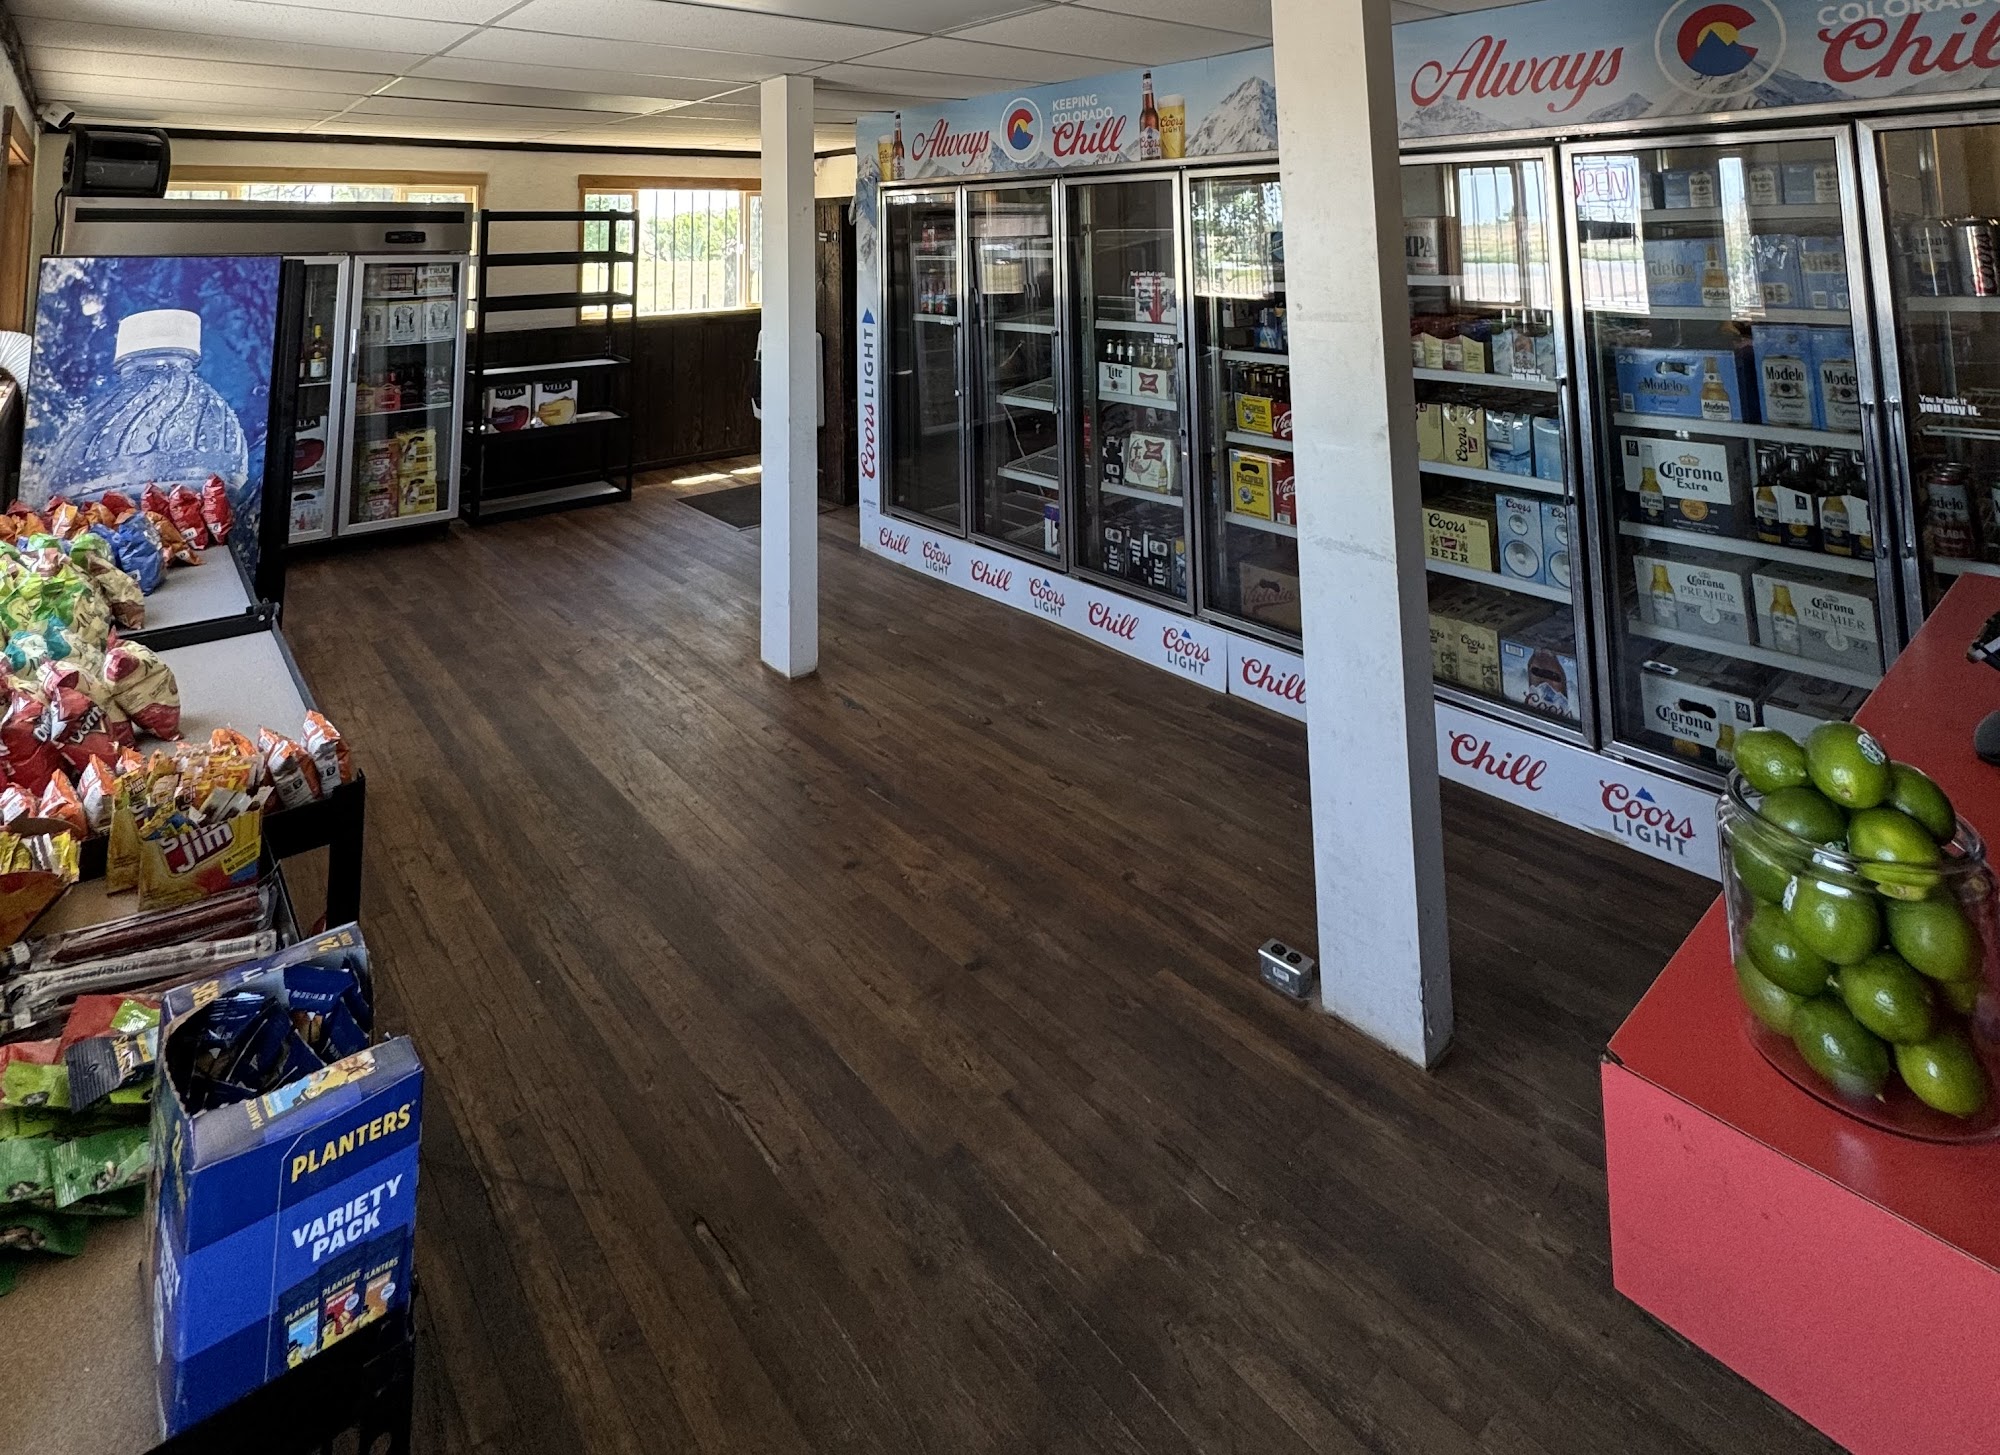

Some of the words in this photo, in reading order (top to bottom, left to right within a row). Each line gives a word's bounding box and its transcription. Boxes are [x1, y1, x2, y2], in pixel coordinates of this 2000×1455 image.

[1411, 34, 1624, 113] Always
[1052, 94, 1098, 111] KEEPING
[1052, 106, 1113, 126] COLORADO
[911, 118, 990, 168] Always
[1052, 115, 1127, 158] Chill
[863, 328, 874, 399] LIGHT
[1619, 355, 1634, 365] 24
[1643, 377, 1683, 392] Modelo
[1765, 366, 1804, 382] Modelo
[1824, 370, 1857, 386] Mode
[498, 388, 523, 397] VELLA
[544, 383, 570, 391] VELLA
[1919, 402, 1942, 413] you
[1943, 403, 1967, 416] buy
[860, 402, 876, 481] Coors
[1456, 427, 1468, 462] Coors
[1659, 461, 1724, 483] Corona
[1677, 478, 1708, 492] Extra
[1505, 498, 1532, 514] Coors
[1428, 512, 1467, 534] Coors
[879, 527, 911, 555] Chill
[922, 540, 952, 565] Coors
[1431, 547, 1469, 564] BEER
[925, 559, 949, 575] LIGHT
[971, 559, 1013, 592] Chill
[1029, 577, 1065, 607] Coors
[1687, 574, 1725, 590] Corona
[1680, 585, 1735, 604] PREMIER
[1034, 598, 1063, 617] LIGHT
[1811, 597, 1855, 615] Corona
[1088, 601, 1140, 641] Chill
[1804, 608, 1866, 631] PREMIER
[1162, 626, 1211, 663] Coors
[1167, 651, 1206, 676] LIGHT
[1656, 705, 1713, 732] Corona
[1738, 704, 1748, 713] 24
[1671, 722, 1700, 739] Extra
[1448, 730, 1548, 792] Chill
[1599, 779, 1697, 839] Coors
[1612, 814, 1687, 856] LIGHT
[291, 1103, 412, 1184] PLANTERS
[291, 1173, 403, 1249] VARIETY
[312, 1207, 381, 1263] PACK
